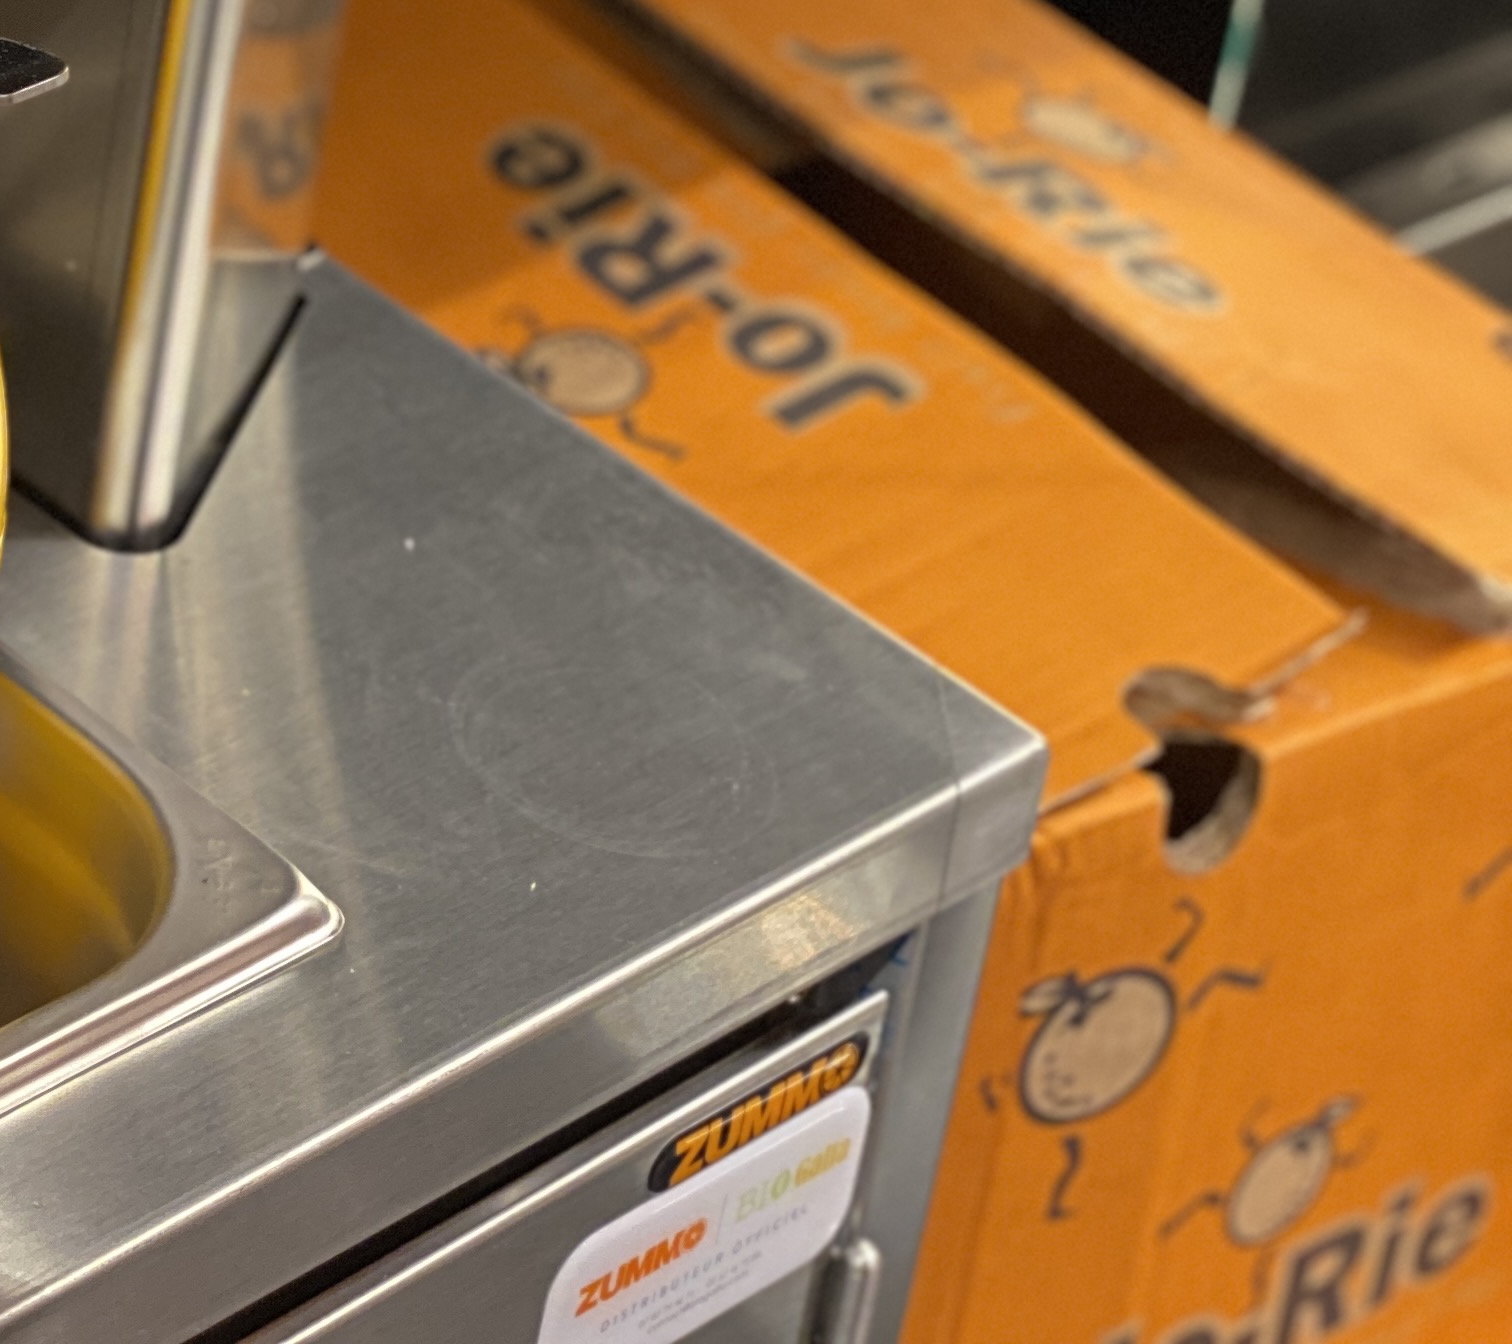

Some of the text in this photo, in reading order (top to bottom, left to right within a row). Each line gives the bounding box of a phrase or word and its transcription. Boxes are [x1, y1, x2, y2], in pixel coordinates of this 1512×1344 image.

[488, 128, 918, 430] Jo-Rie
[669, 1043, 860, 1188] ZUMMO
[575, 1217, 708, 1317] ZUMMO
[600, 1251, 724, 1334] DISTRIBUTEUR
